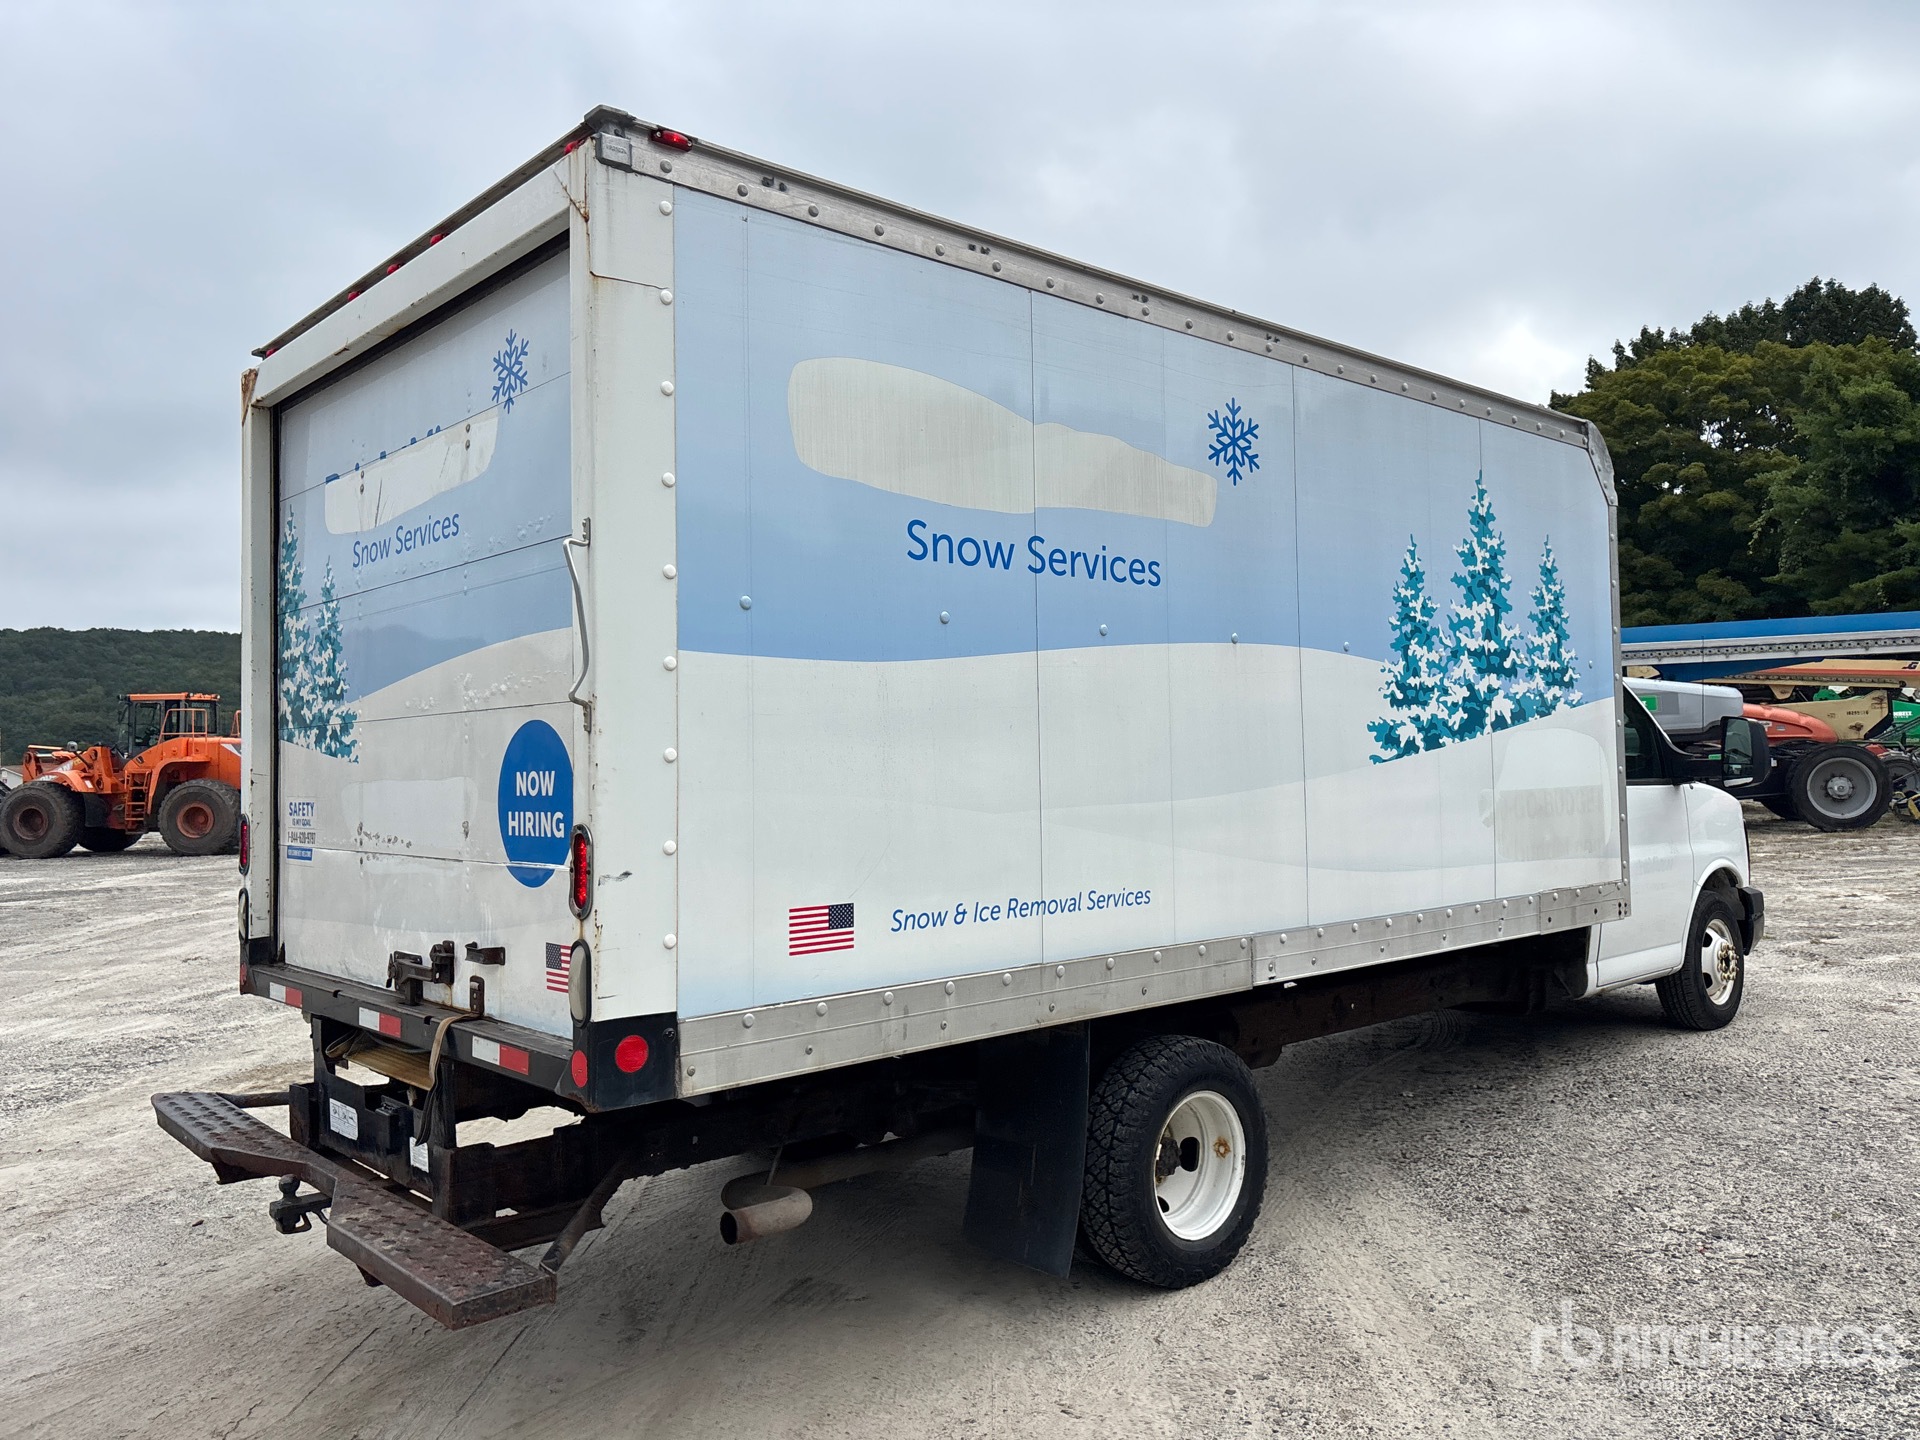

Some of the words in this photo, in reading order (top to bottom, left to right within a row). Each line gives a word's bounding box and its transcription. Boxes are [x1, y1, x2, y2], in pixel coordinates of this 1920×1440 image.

[352, 537, 391, 568] Snow
[395, 512, 460, 555] Services
[907, 519, 1015, 570] Snow
[1027, 535, 1161, 587] Services
[515, 770, 556, 797] NOW
[288, 801, 315, 817] SAFETY
[508, 810, 565, 838] HIRING
[890, 909, 949, 932] Snow
[953, 903, 967, 926] &
[973, 901, 1001, 923] Ice
[1006, 891, 1082, 919] Removal
[1086, 888, 1151, 911] Services
